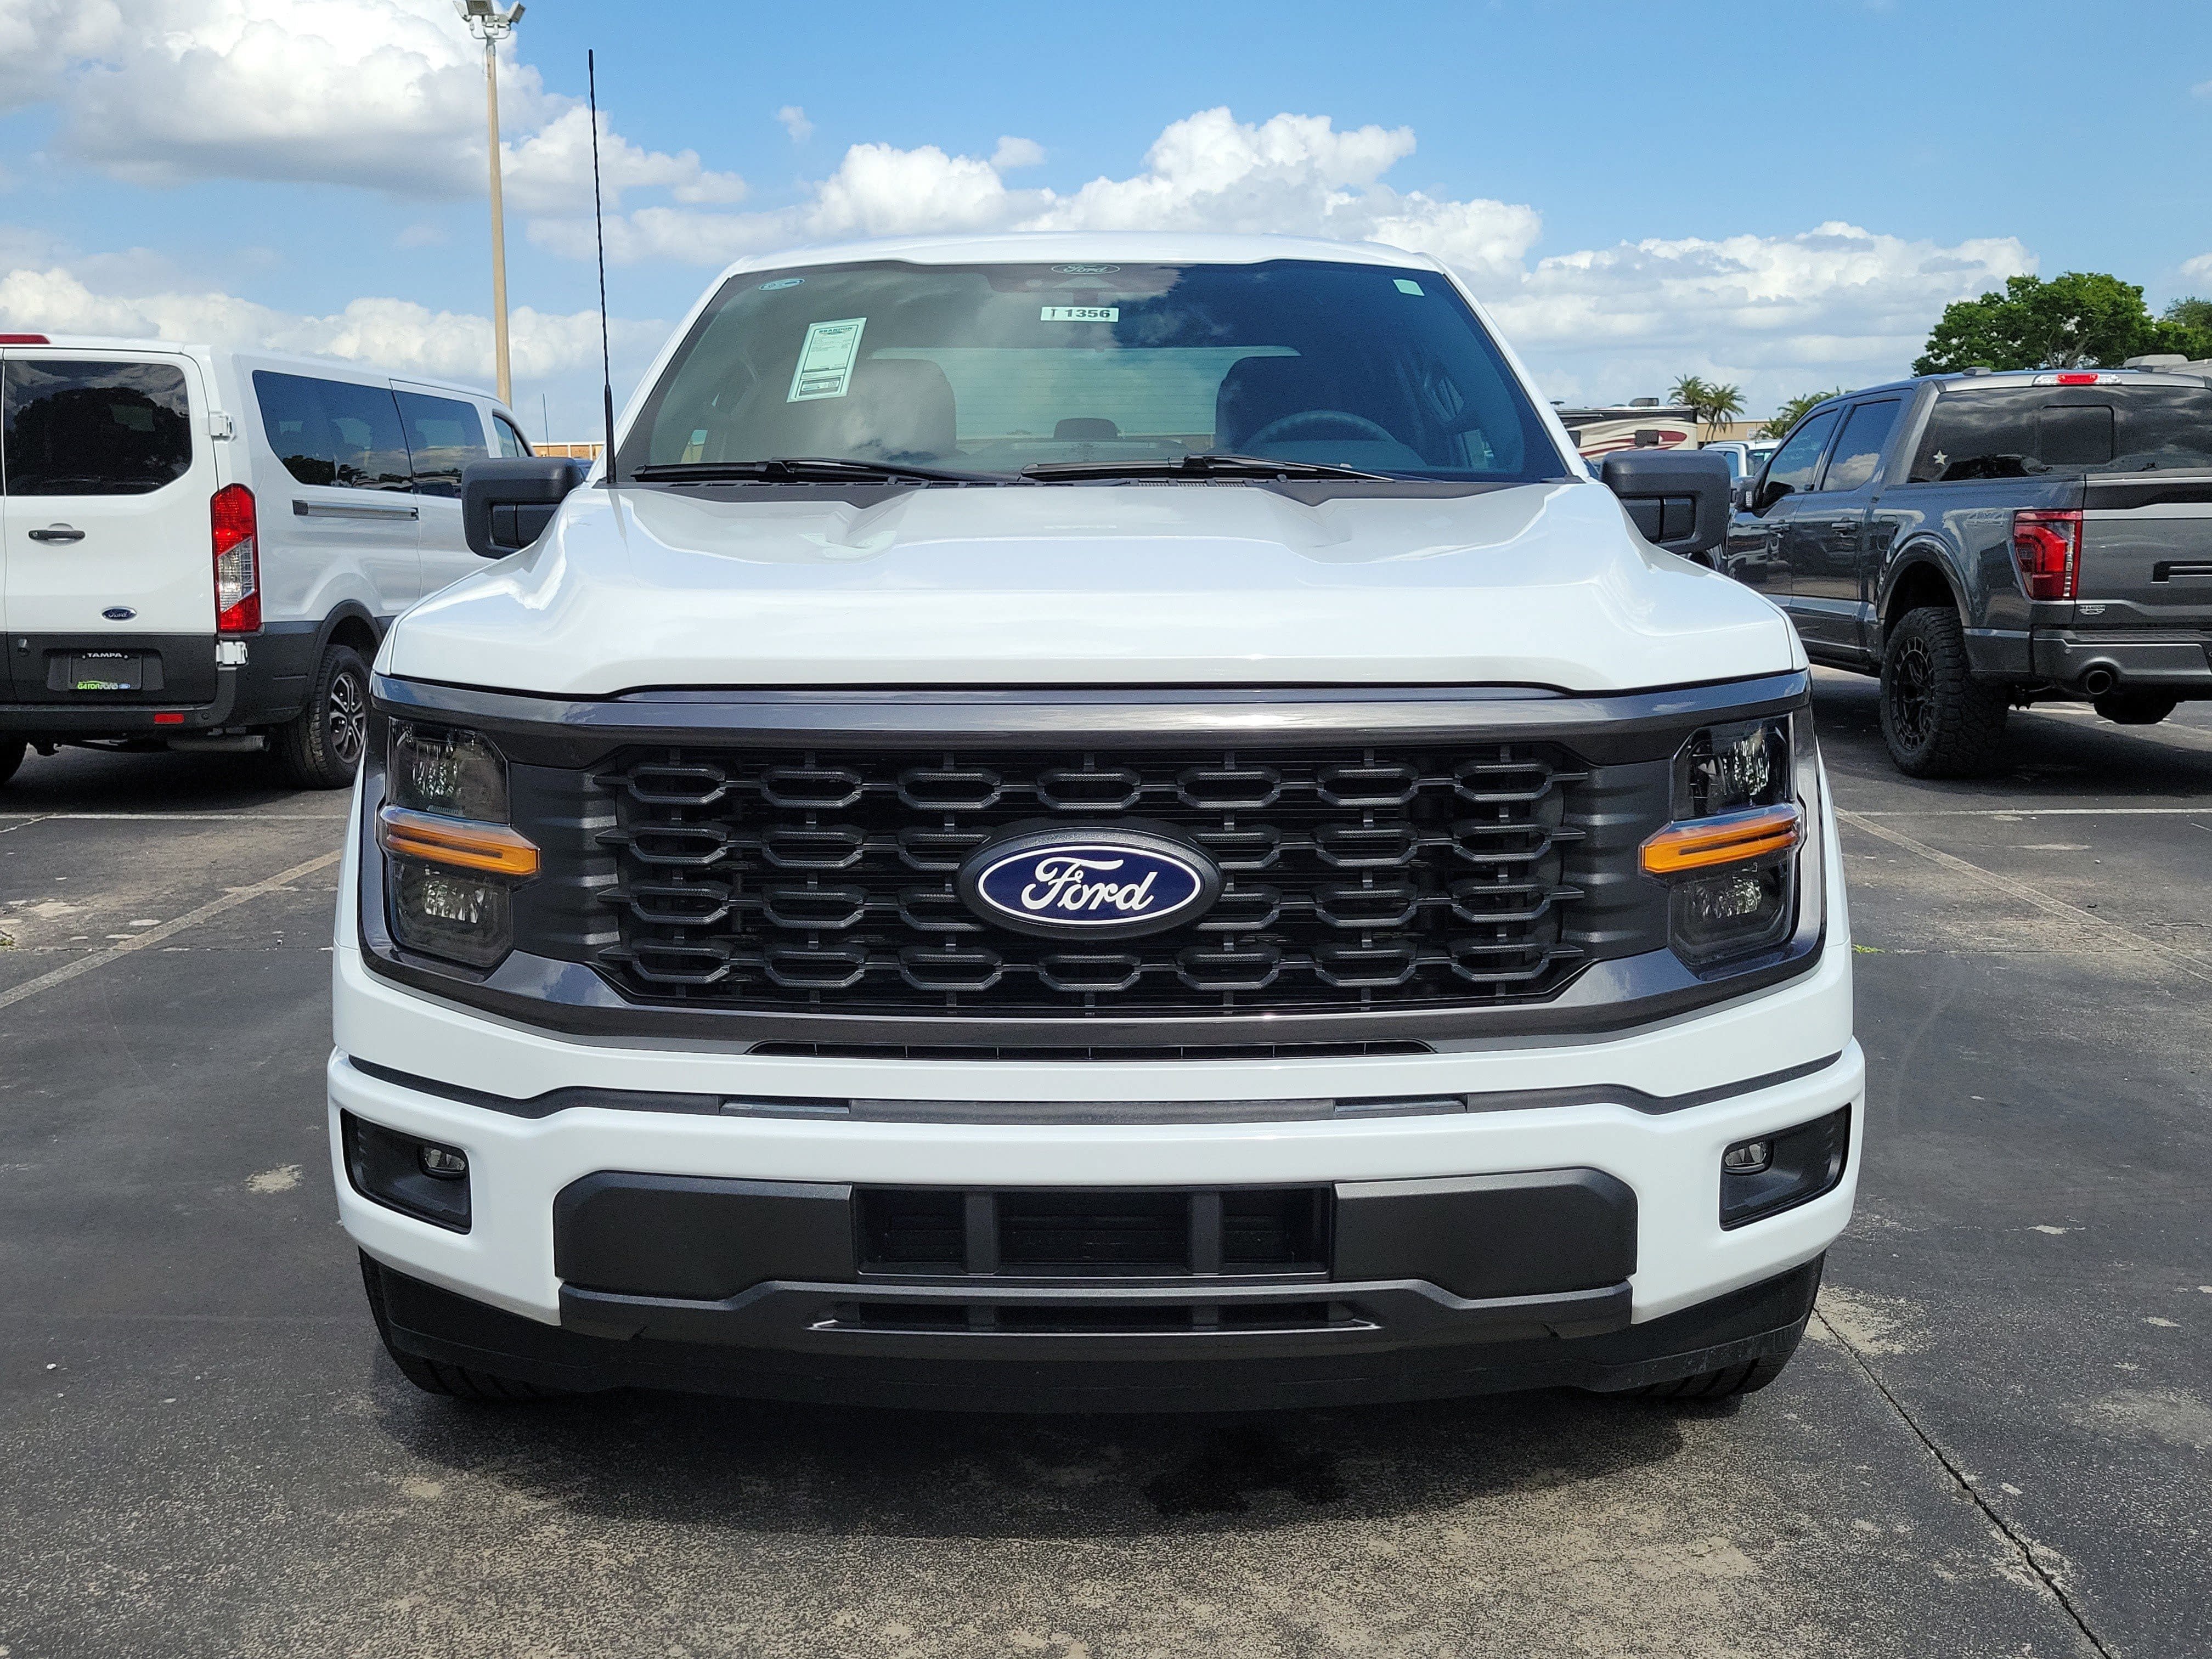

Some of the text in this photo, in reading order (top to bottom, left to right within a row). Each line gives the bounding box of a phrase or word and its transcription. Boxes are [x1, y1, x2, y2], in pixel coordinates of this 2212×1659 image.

[1051, 309, 1111, 318] T 1356
[1021, 856, 1158, 911] Ford
